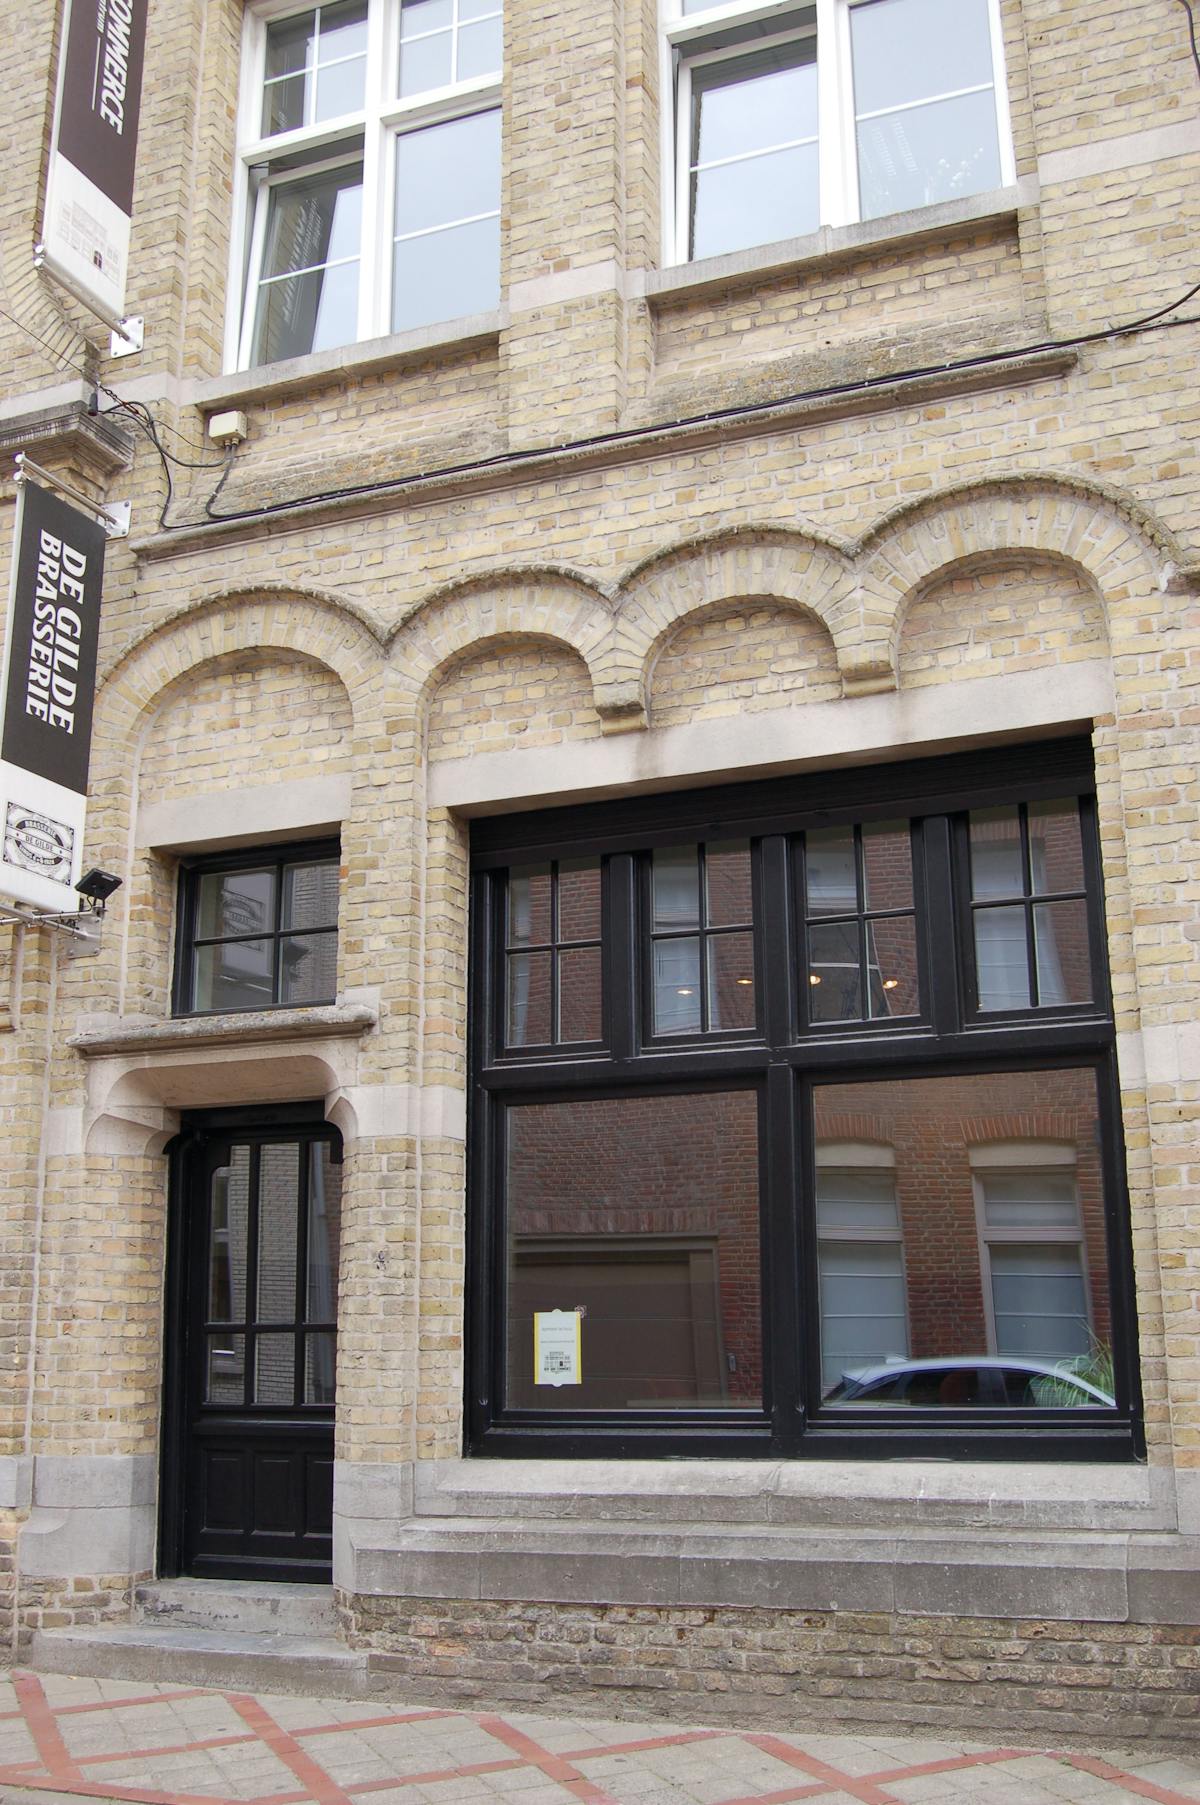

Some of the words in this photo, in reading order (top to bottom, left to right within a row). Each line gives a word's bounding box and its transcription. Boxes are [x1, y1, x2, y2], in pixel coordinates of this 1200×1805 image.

[26, 529, 62, 722] BRASSERIE
[60, 543, 86, 604] DE
[49, 606, 82, 735] GILDE
